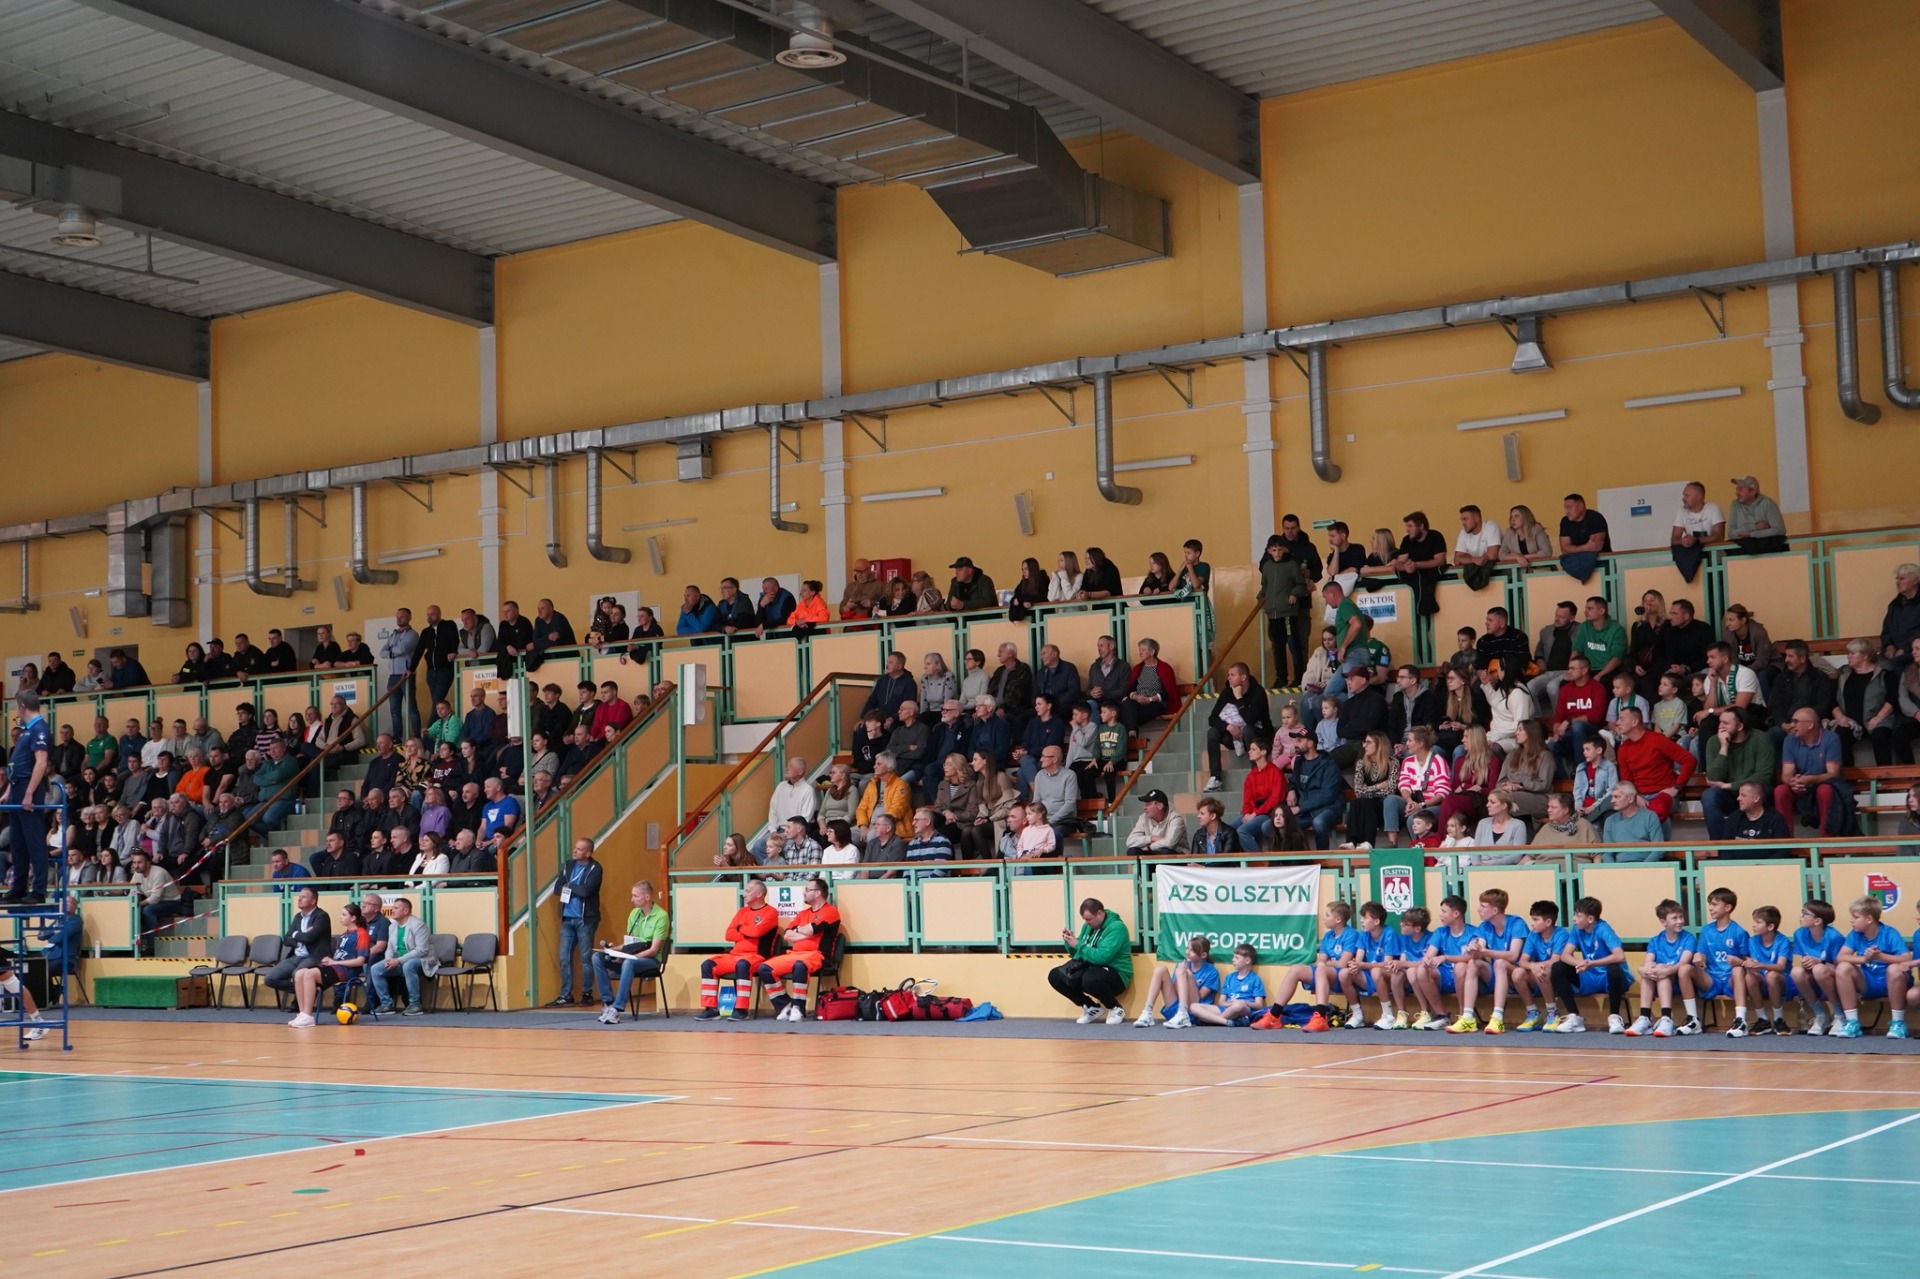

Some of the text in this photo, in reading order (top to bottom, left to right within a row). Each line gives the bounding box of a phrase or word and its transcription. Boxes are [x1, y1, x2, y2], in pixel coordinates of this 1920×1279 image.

[1358, 595, 1394, 605] SEKTOR
[474, 672, 497, 680] SEKTOR
[335, 683, 355, 691] SEKTOR
[1168, 885, 1310, 903] AZS OLSZTYN
[1174, 931, 1304, 950] WGORZEWO
[1715, 951, 1727, 962] 22
